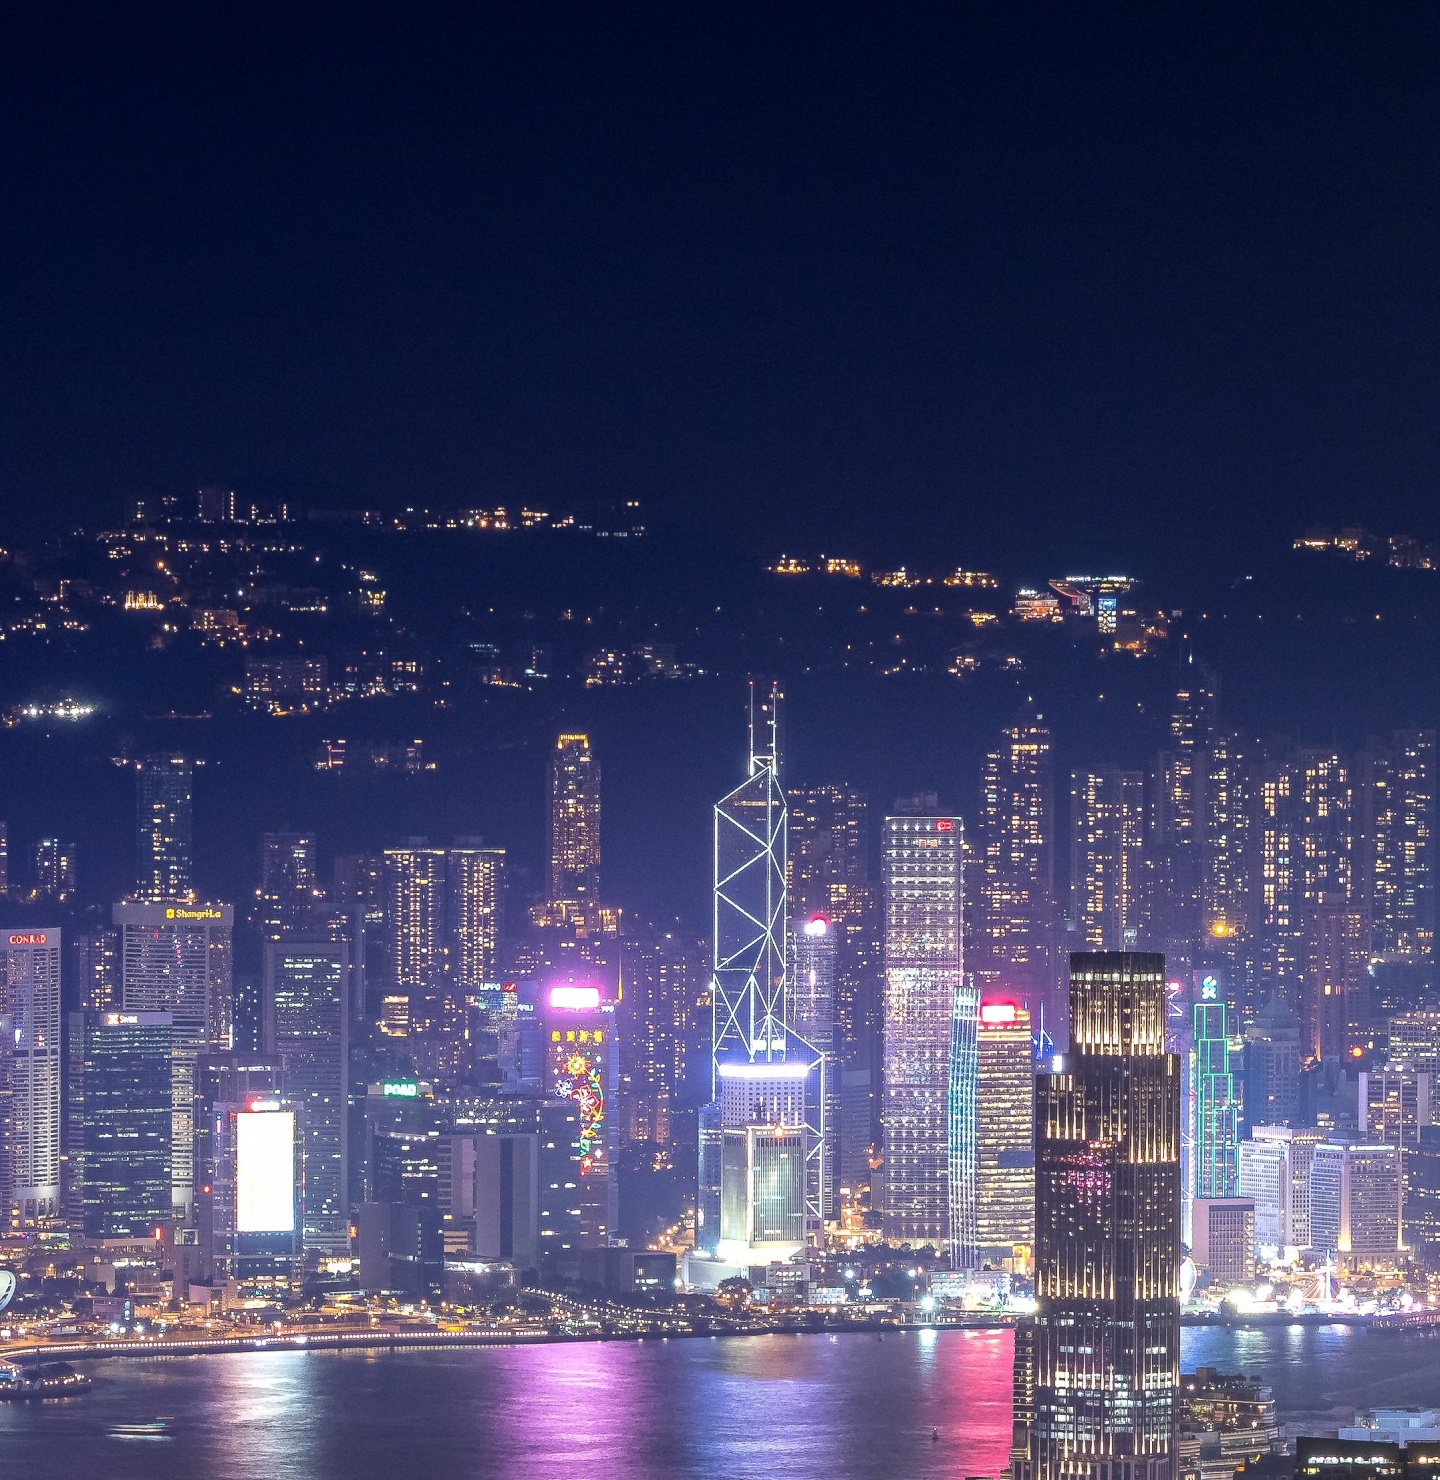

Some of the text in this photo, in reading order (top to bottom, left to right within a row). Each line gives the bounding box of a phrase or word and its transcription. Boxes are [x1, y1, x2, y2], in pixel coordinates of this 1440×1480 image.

[175, 908, 221, 920] Shangri-La
[9, 933, 47, 945] CONRAD
[479, 983, 501, 991] LIPPO
[384, 1083, 417, 1097] POAD
